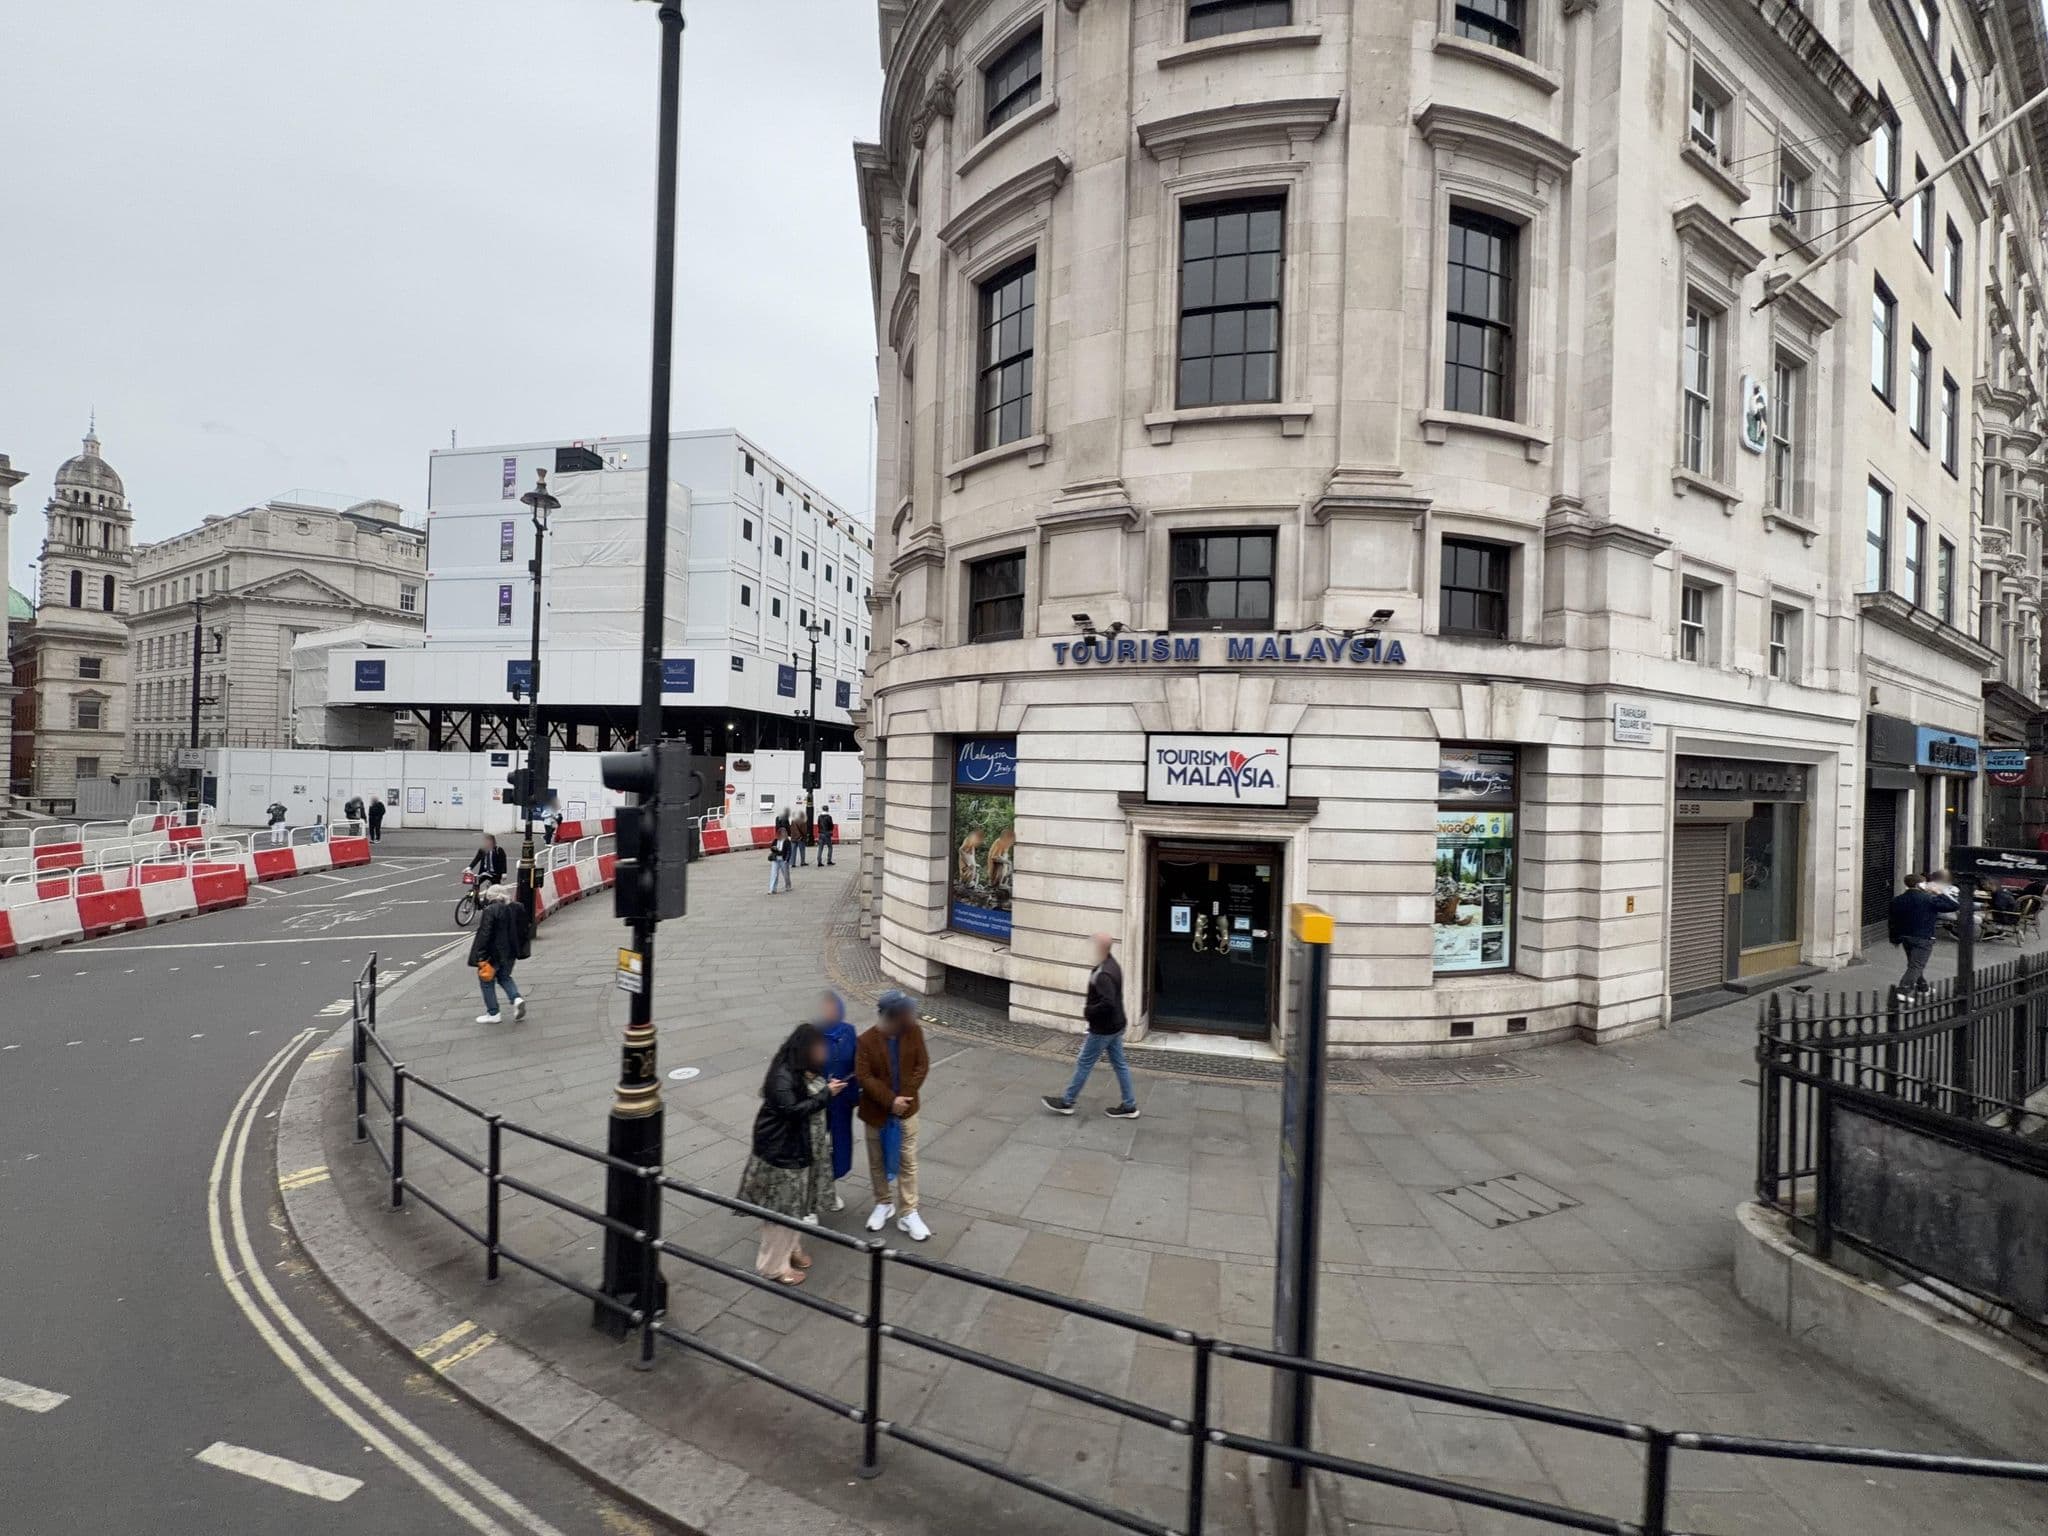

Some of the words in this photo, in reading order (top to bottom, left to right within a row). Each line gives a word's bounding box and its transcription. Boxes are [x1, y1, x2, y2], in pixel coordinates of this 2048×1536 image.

[1052, 637, 1201, 665] TOURISM
[1226, 637, 1408, 665] MALAYSIA
[959, 741, 1016, 781] Malaysia
[1156, 749, 1229, 766] TOURISM
[1166, 765, 1275, 798] MALAYSIA
[1676, 767, 1745, 790] UGANDA
[1751, 772, 1802, 792] HOUSE
